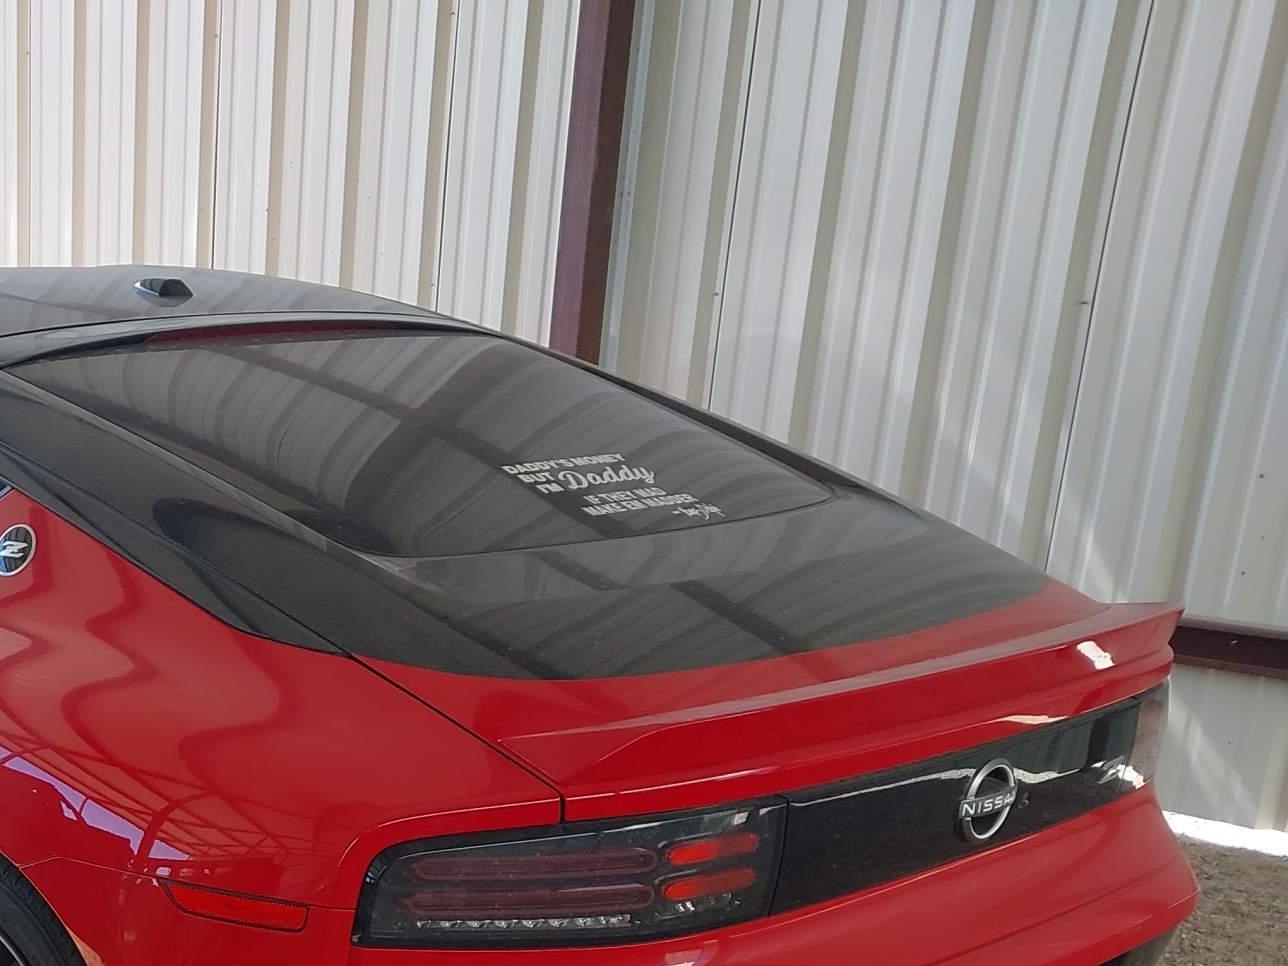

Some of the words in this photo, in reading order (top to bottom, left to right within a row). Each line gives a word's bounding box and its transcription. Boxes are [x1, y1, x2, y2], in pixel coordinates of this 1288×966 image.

[501, 459, 575, 474] DADDY'S
[569, 453, 626, 466] MONEY
[517, 471, 555, 483] BUT
[535, 482, 565, 493] I'M
[558, 464, 655, 489] Daddy
[582, 494, 601, 504] IF
[597, 490, 638, 502] THEY
[632, 487, 667, 498] MAD
[581, 503, 629, 516] MAKE
